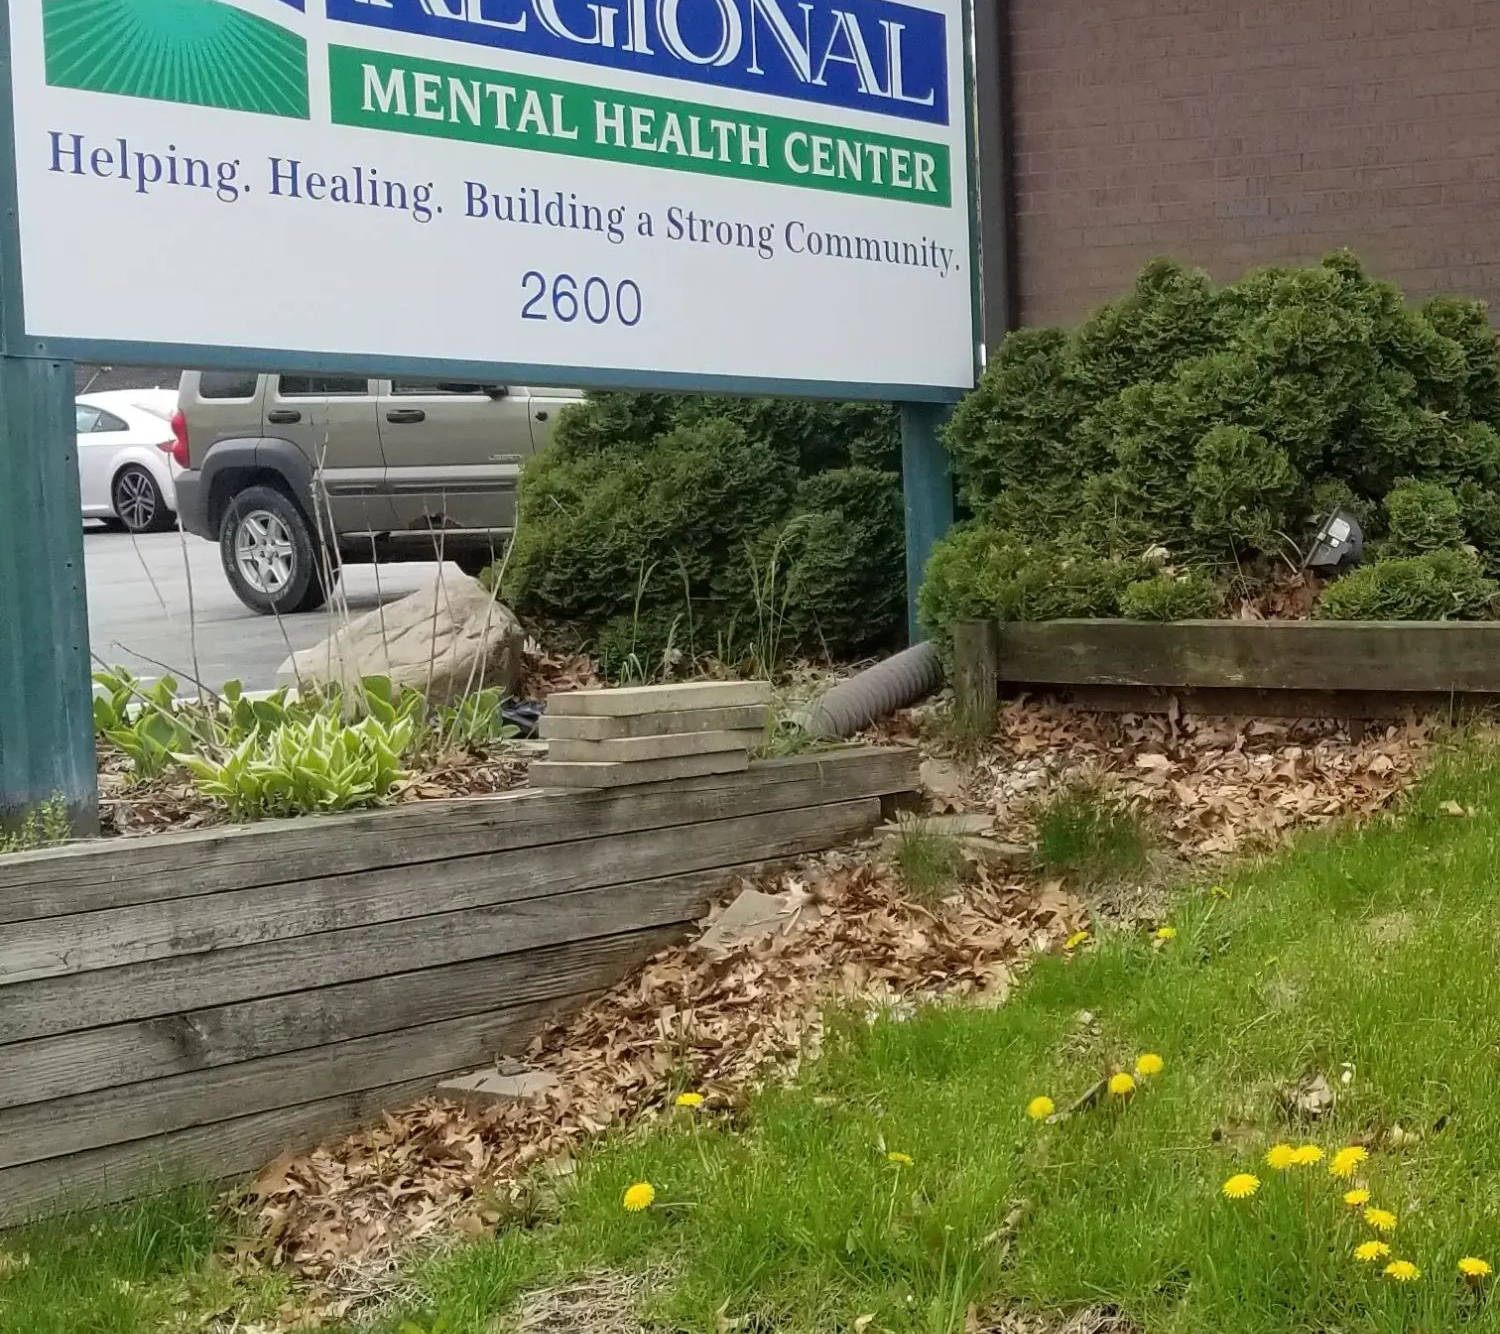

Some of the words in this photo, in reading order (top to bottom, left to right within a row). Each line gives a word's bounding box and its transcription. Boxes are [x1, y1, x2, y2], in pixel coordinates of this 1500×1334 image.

[361, 63, 578, 140] MENTAL
[593, 100, 769, 168] HEALTH
[784, 131, 938, 192] CENTER
[47, 130, 251, 203] Helping.
[267, 156, 443, 224] Healing.
[463, 181, 625, 245] Building
[637, 211, 655, 238] a
[666, 206, 775, 259] Strong
[784, 220, 961, 278] Community.
[520, 270, 643, 327] 2600
